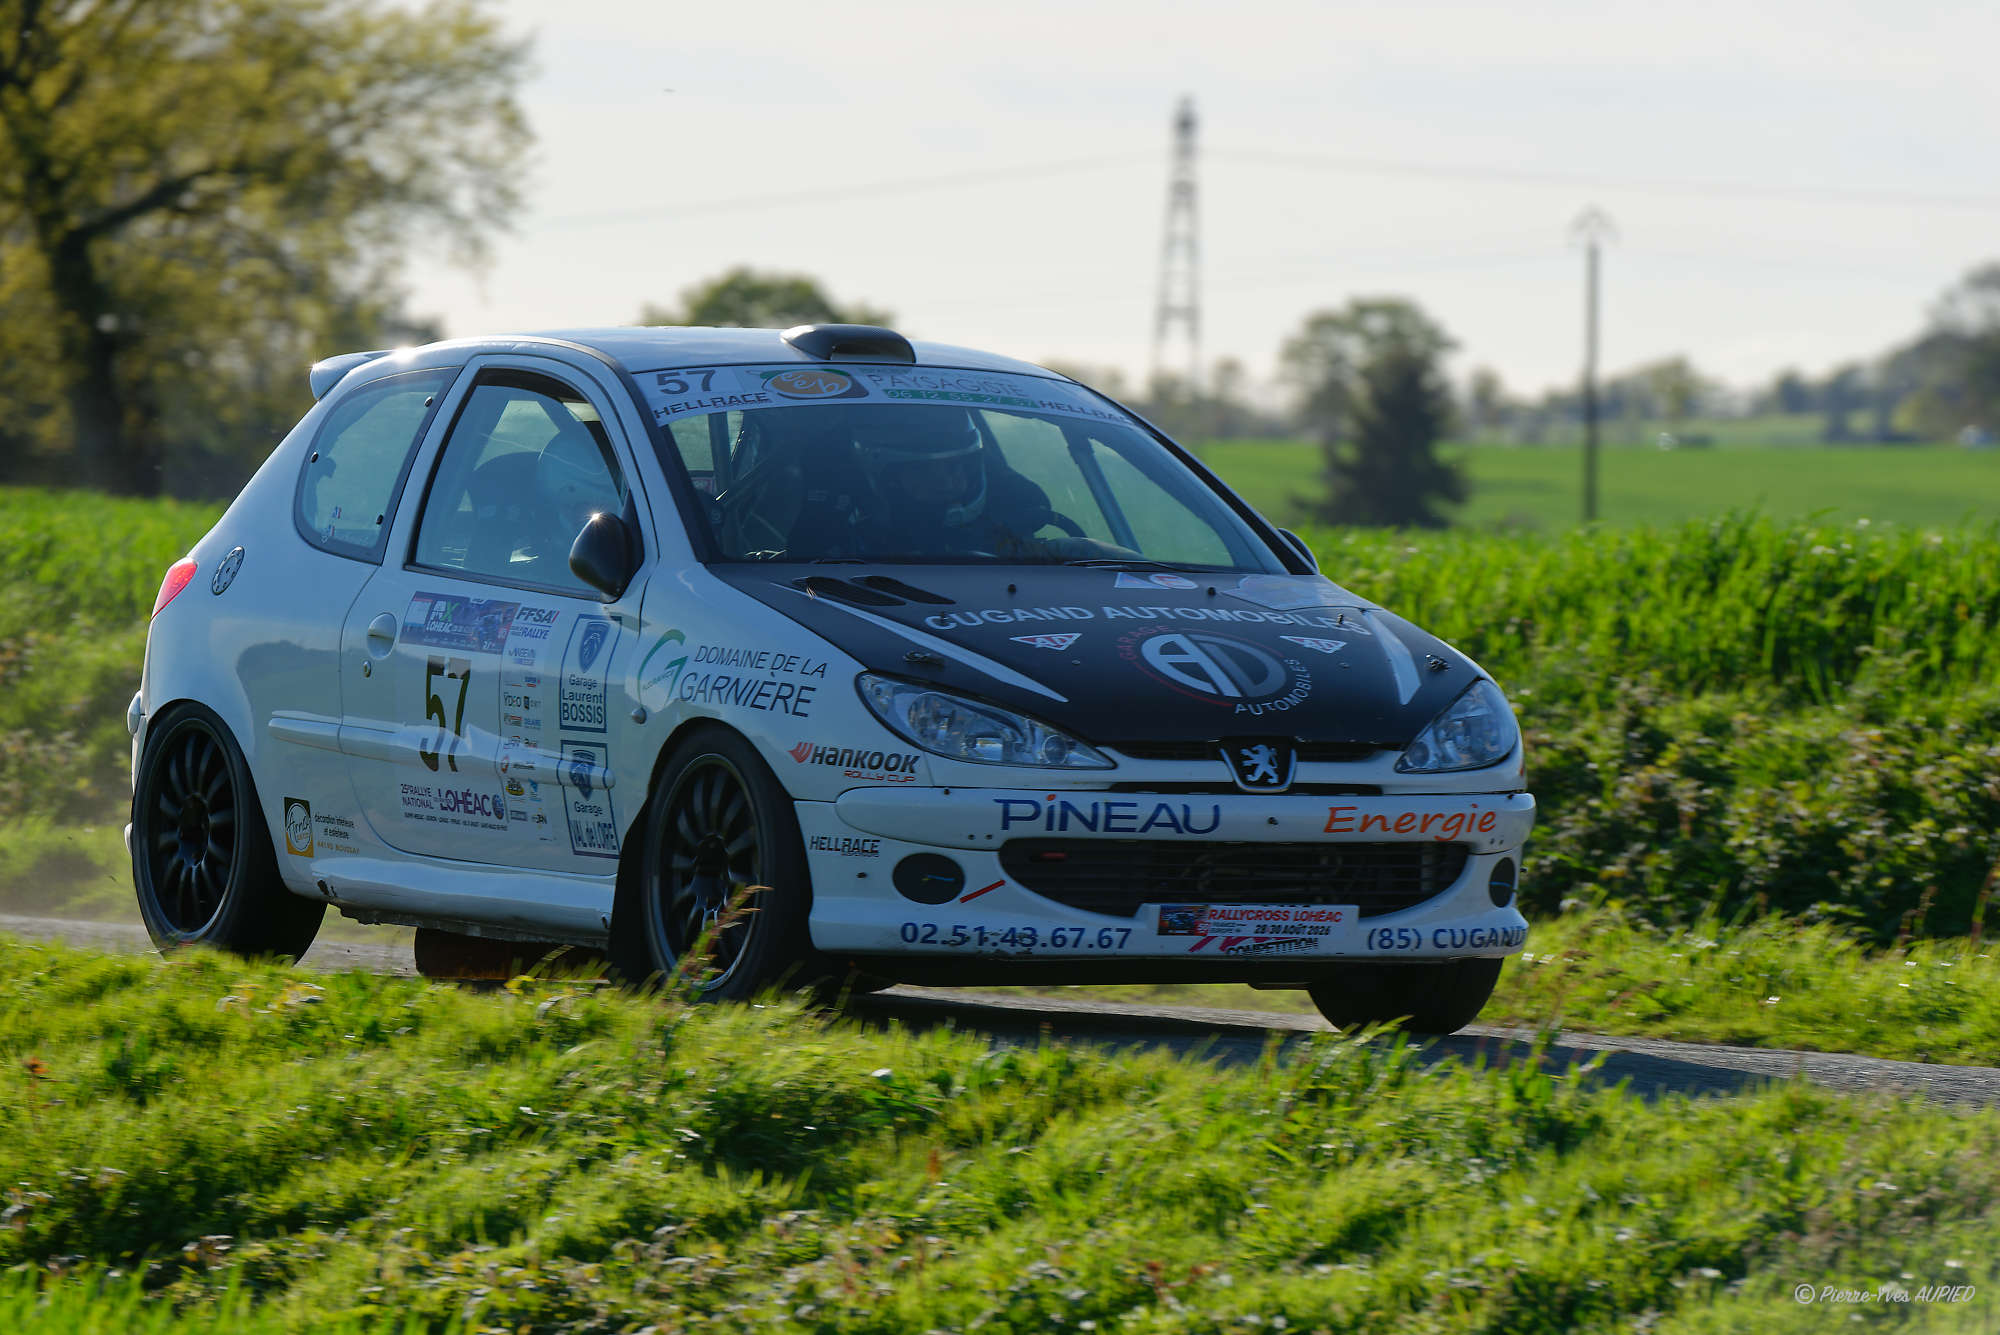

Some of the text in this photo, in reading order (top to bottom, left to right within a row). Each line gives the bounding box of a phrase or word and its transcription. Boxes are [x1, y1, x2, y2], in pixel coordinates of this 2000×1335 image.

[657, 370, 715, 395] 57
[867, 373, 1029, 398] PAYSAGISTE
[887, 390, 912, 399] 06
[654, 392, 770, 419] HELLRACE
[516, 606, 555, 624] FFSA
[925, 606, 1095, 631] CUGAND
[1103, 605, 1373, 637] AUTOMOBILES
[520, 626, 550, 640] RALLYE
[694, 645, 828, 678] DOMAINE DE LA
[568, 674, 598, 690] Garage
[679, 671, 817, 717] GARNIÈRE
[1234, 659, 1313, 716] AUTOMOBILES
[562, 688, 603, 704] Laurent
[420, 655, 472, 772] 57
[562, 703, 603, 724] BOSSIS
[401, 796, 434, 809] NATIONAL
[408, 784, 432, 797] RALLYE
[437, 788, 492, 816] LOHÉAC
[574, 801, 603, 816] Garage
[1323, 803, 1497, 841] Energie
[810, 836, 881, 854] HELLRACE
[1208, 909, 1343, 923] RALLYCROSS LOHÉAC
[900, 921, 1132, 949] 02.51.43.67.67
[1225, 937, 1319, 956] COMPETITION
[1367, 926, 1422, 951] (85)
